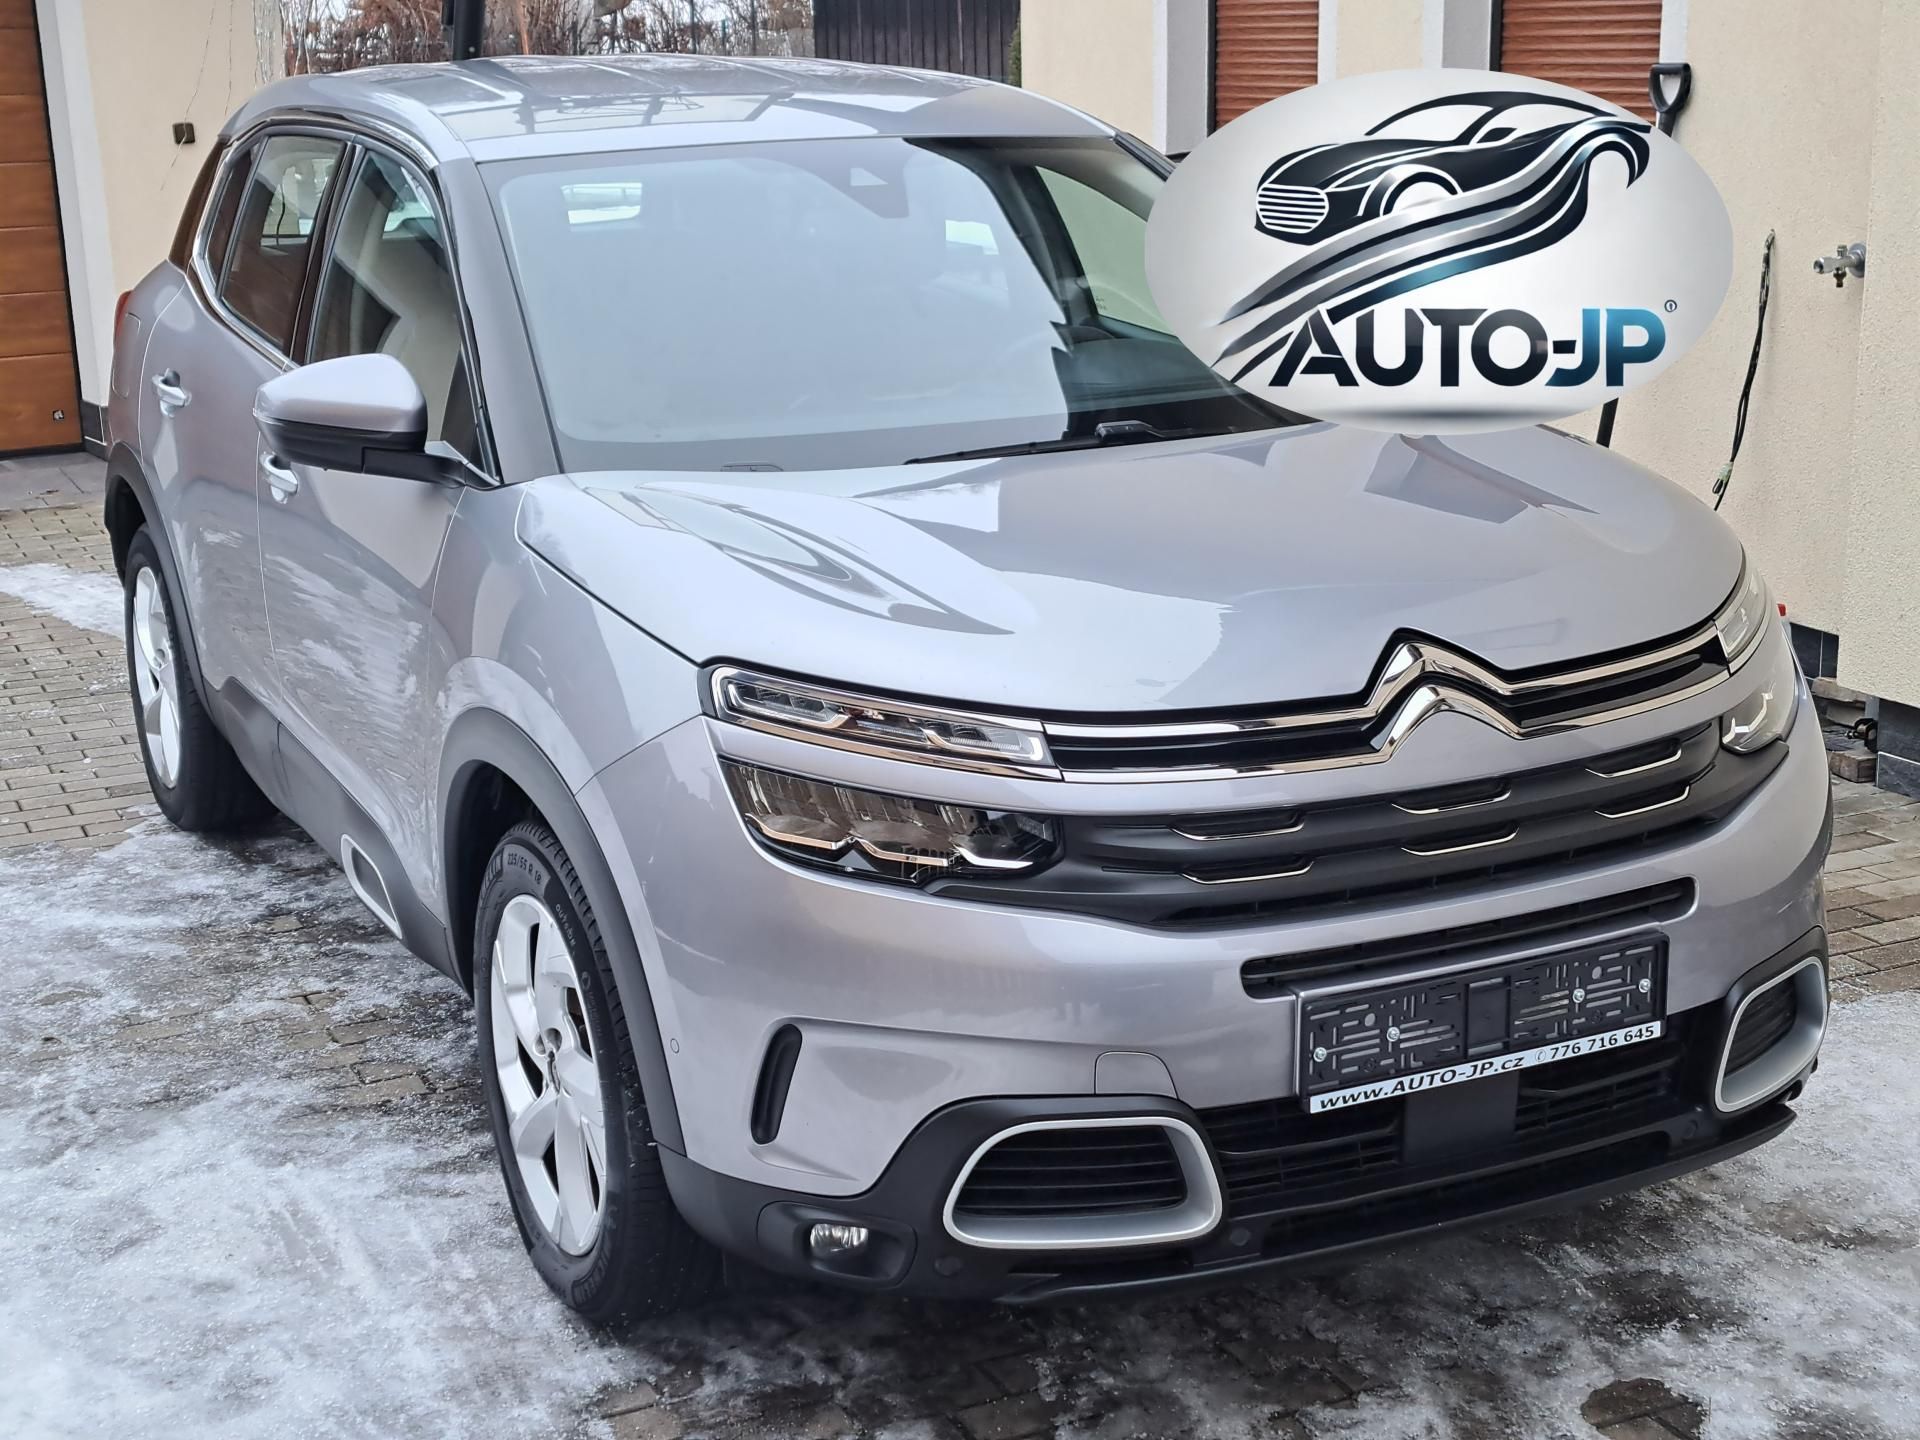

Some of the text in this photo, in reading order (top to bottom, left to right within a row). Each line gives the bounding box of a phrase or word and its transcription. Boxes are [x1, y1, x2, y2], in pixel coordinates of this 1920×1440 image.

[1319, 1026, 1655, 1109] www.AUTO-JP.cz 776 716 645
